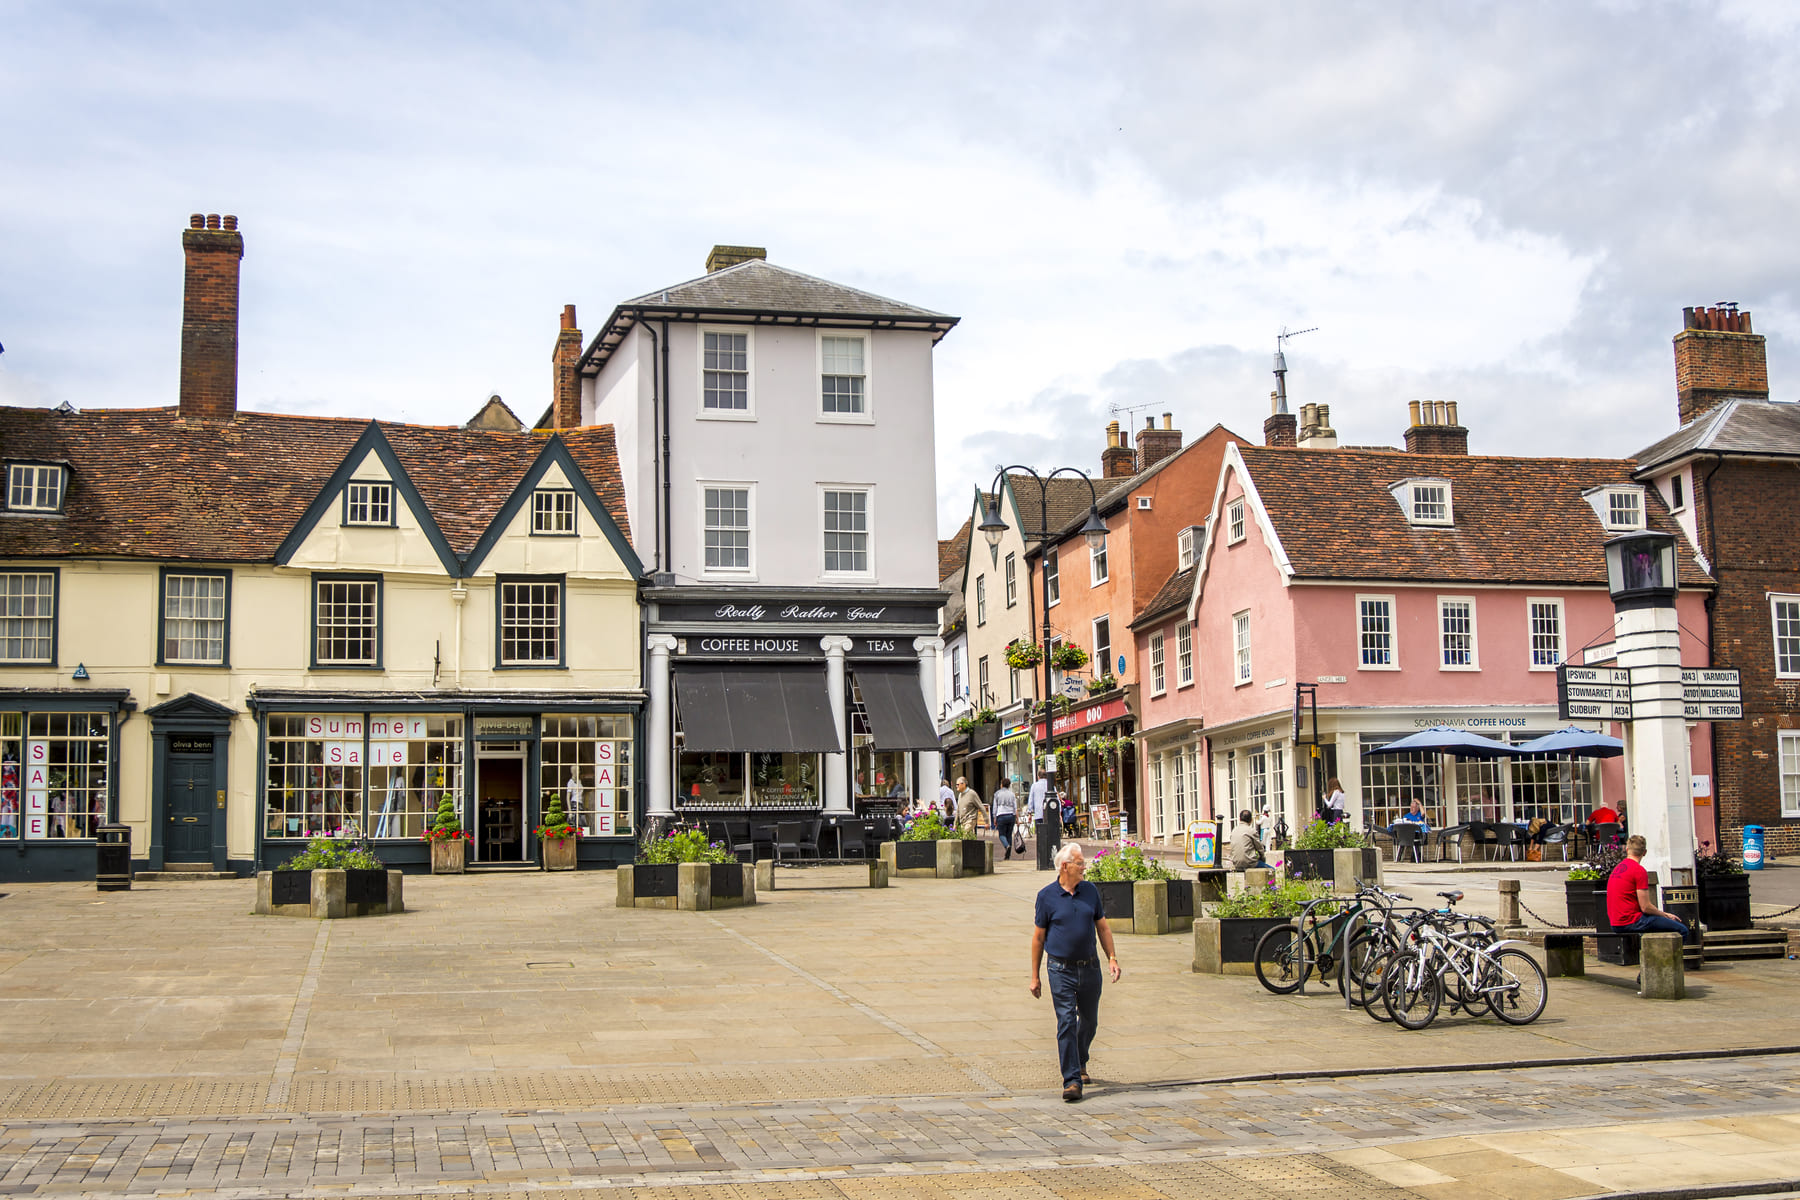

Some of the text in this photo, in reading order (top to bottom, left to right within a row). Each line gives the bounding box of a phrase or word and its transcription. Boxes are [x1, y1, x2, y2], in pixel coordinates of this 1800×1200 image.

[714, 604, 886, 621] Really Rather Good
[701, 639, 799, 651] COFFEE HOUSE
[866, 640, 895, 651] TEAS
[1567, 670, 1597, 680] IPSWICH
[1681, 672, 1738, 681] A143 YARMOUTH
[1568, 687, 1612, 698] STOWMARKET
[1683, 689, 1740, 698] A1101 MILDENHALL
[1569, 705, 1629, 715] SUDBURY A134
[1684, 705, 1741, 715] A134 THETFORD
[310, 717, 422, 735] Summer
[1467, 718, 1497, 727] COFFEE
[1499, 718, 1526, 727] HOUSE
[172, 740, 212, 748] olivia benn
[330, 747, 402, 763] Sale
[31, 745, 44, 833] SALE
[599, 744, 612, 832] SALE
